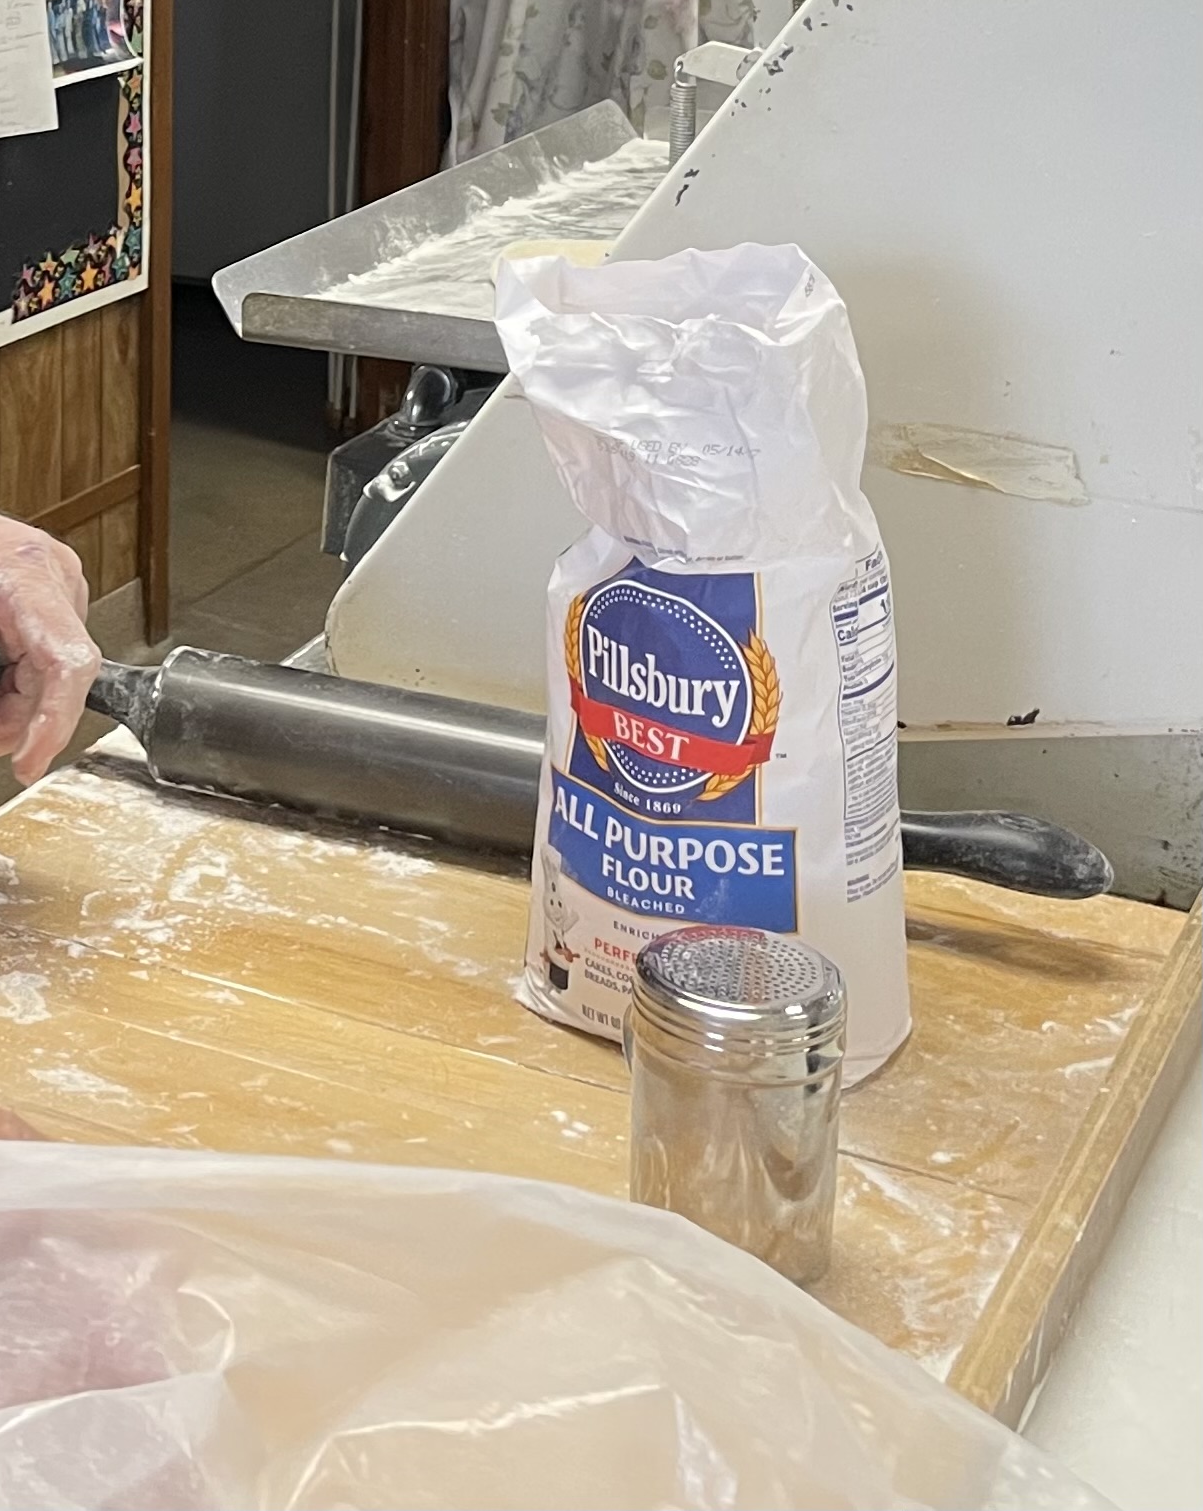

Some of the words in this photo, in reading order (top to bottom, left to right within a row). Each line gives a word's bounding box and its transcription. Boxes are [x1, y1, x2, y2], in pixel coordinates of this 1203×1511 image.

[631, 439, 662, 452] USED
[586, 624, 741, 728] Pillsbury
[613, 711, 690, 761] BEST
[613, 781, 640, 806] Since
[646, 798, 682, 815] 1869
[554, 786, 599, 841] ALL
[604, 816, 785, 876] PURPOSE
[601, 853, 695, 900] FLOUR
[607, 886, 685, 915] BLEACHED
[613, 920, 661, 940] ENRICH
[594, 937, 637, 963] PERFE
